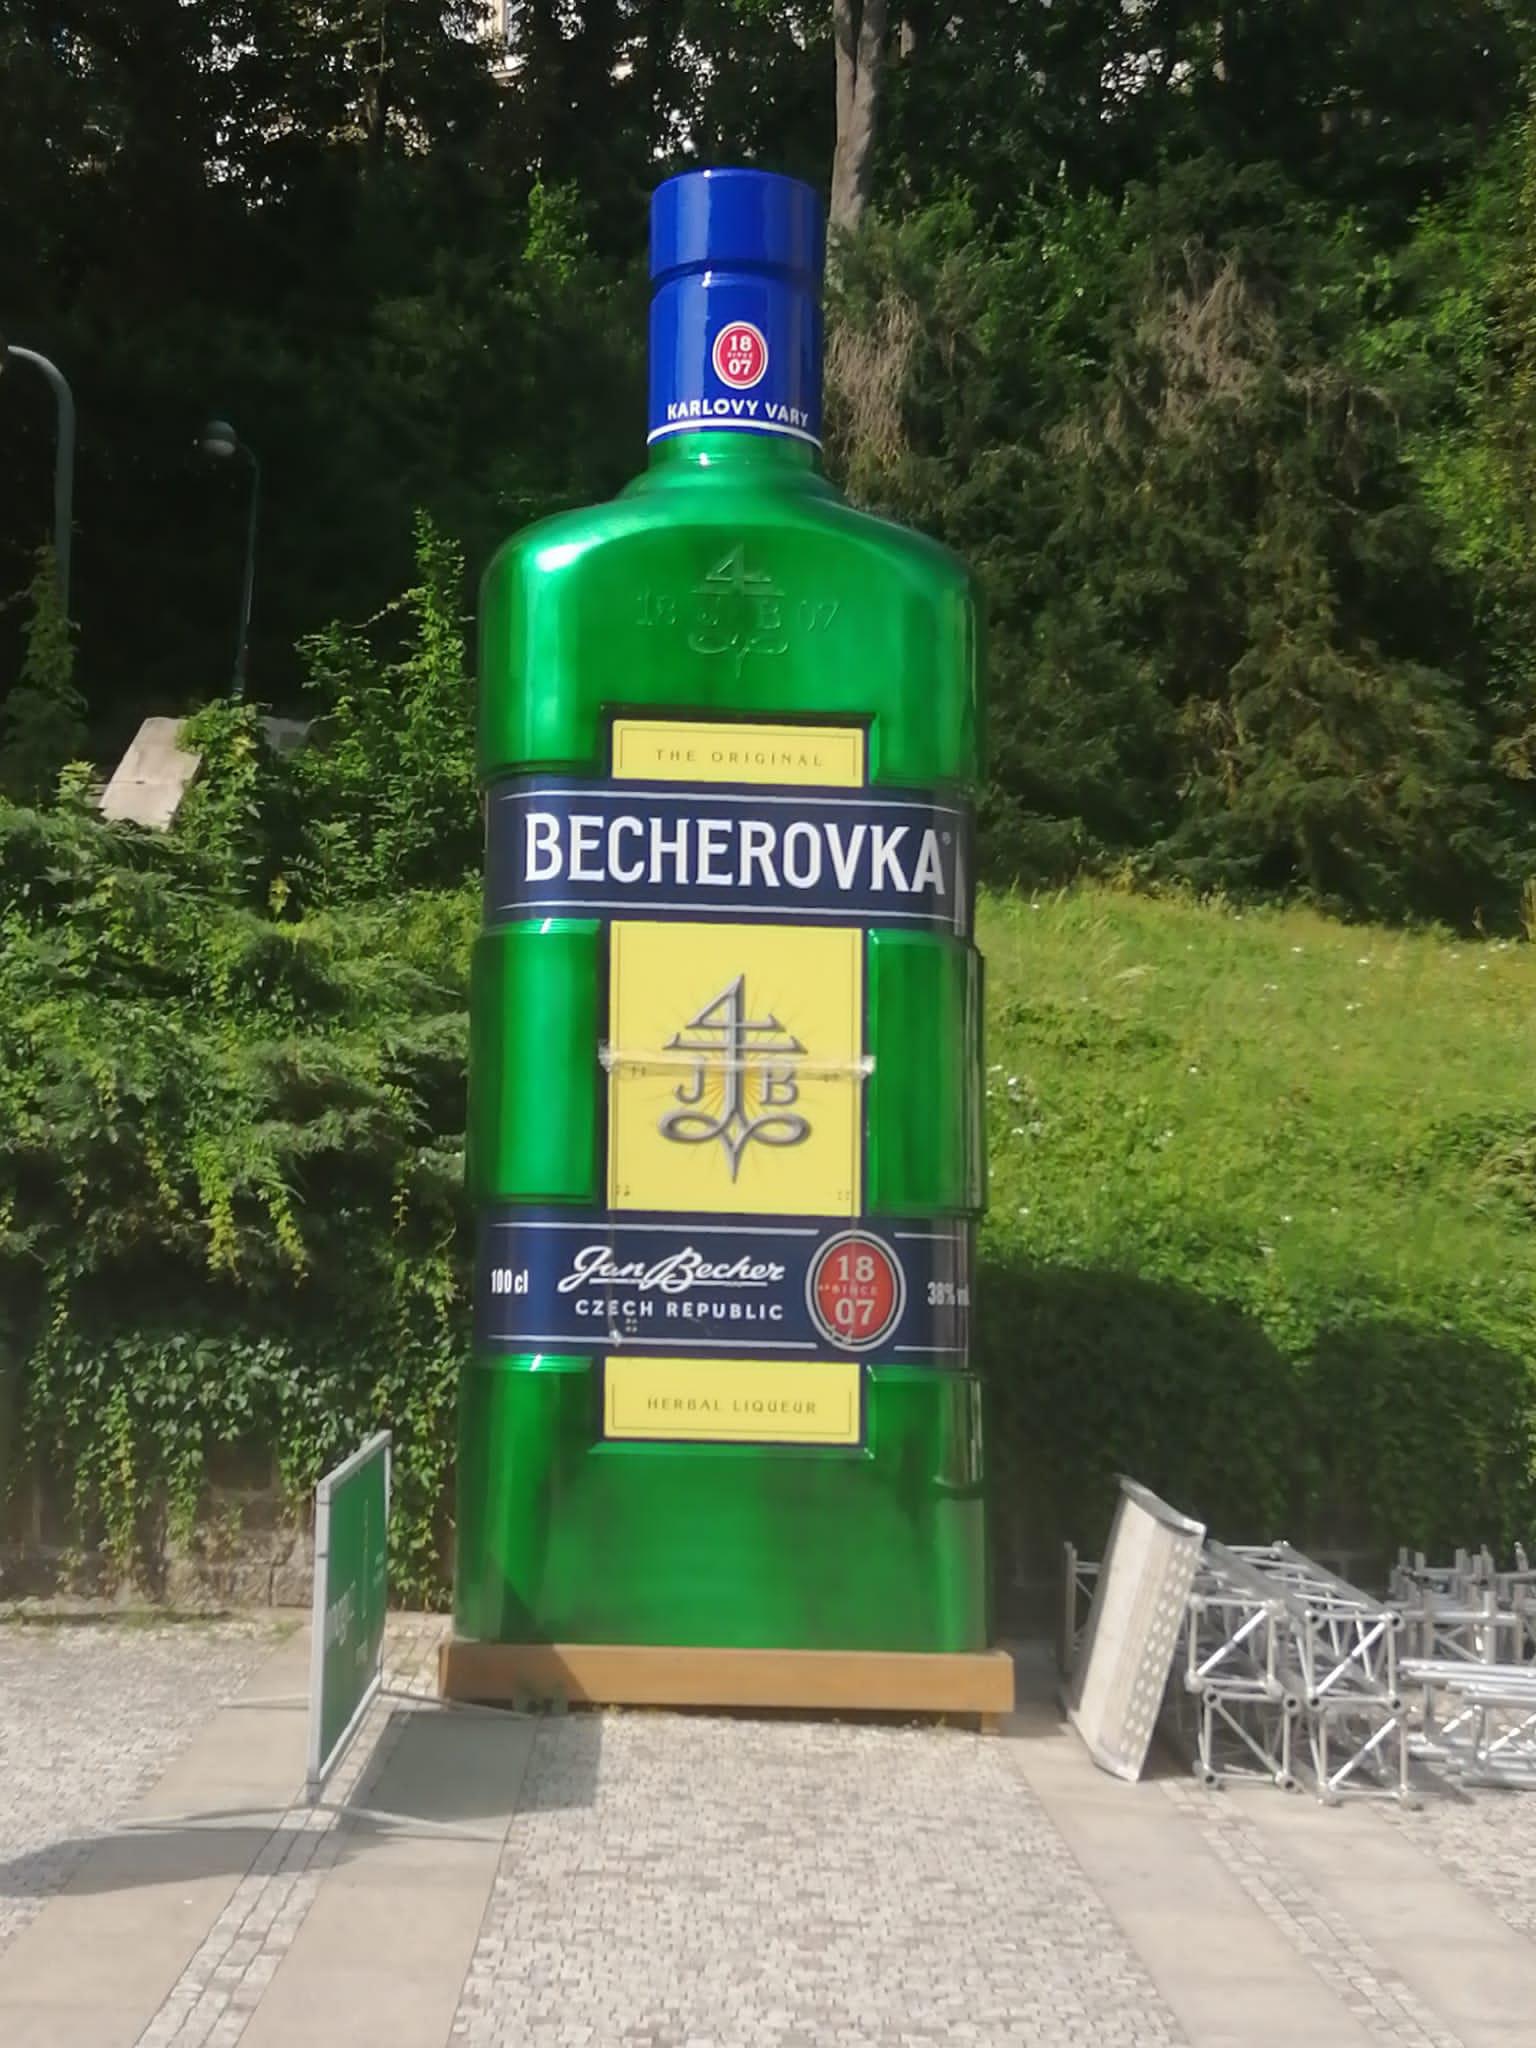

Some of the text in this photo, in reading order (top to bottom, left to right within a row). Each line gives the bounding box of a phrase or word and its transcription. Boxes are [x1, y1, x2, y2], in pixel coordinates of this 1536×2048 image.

[730, 335, 752, 352] 18
[728, 359, 752, 375] 07
[667, 398, 809, 427] KARLOVY VARY
[656, 749, 824, 768] THE ORIGINAL
[525, 812, 946, 896] BECHEROVKA
[491, 1268, 529, 1295] 100 cl
[638, 1246, 786, 1295] Becher
[837, 1255, 876, 1282] 18
[575, 1299, 784, 1321] CZECH REPUBLIC
[835, 1298, 876, 1326] 07
[647, 1397, 817, 1415] HERBAL LIQUEUR
